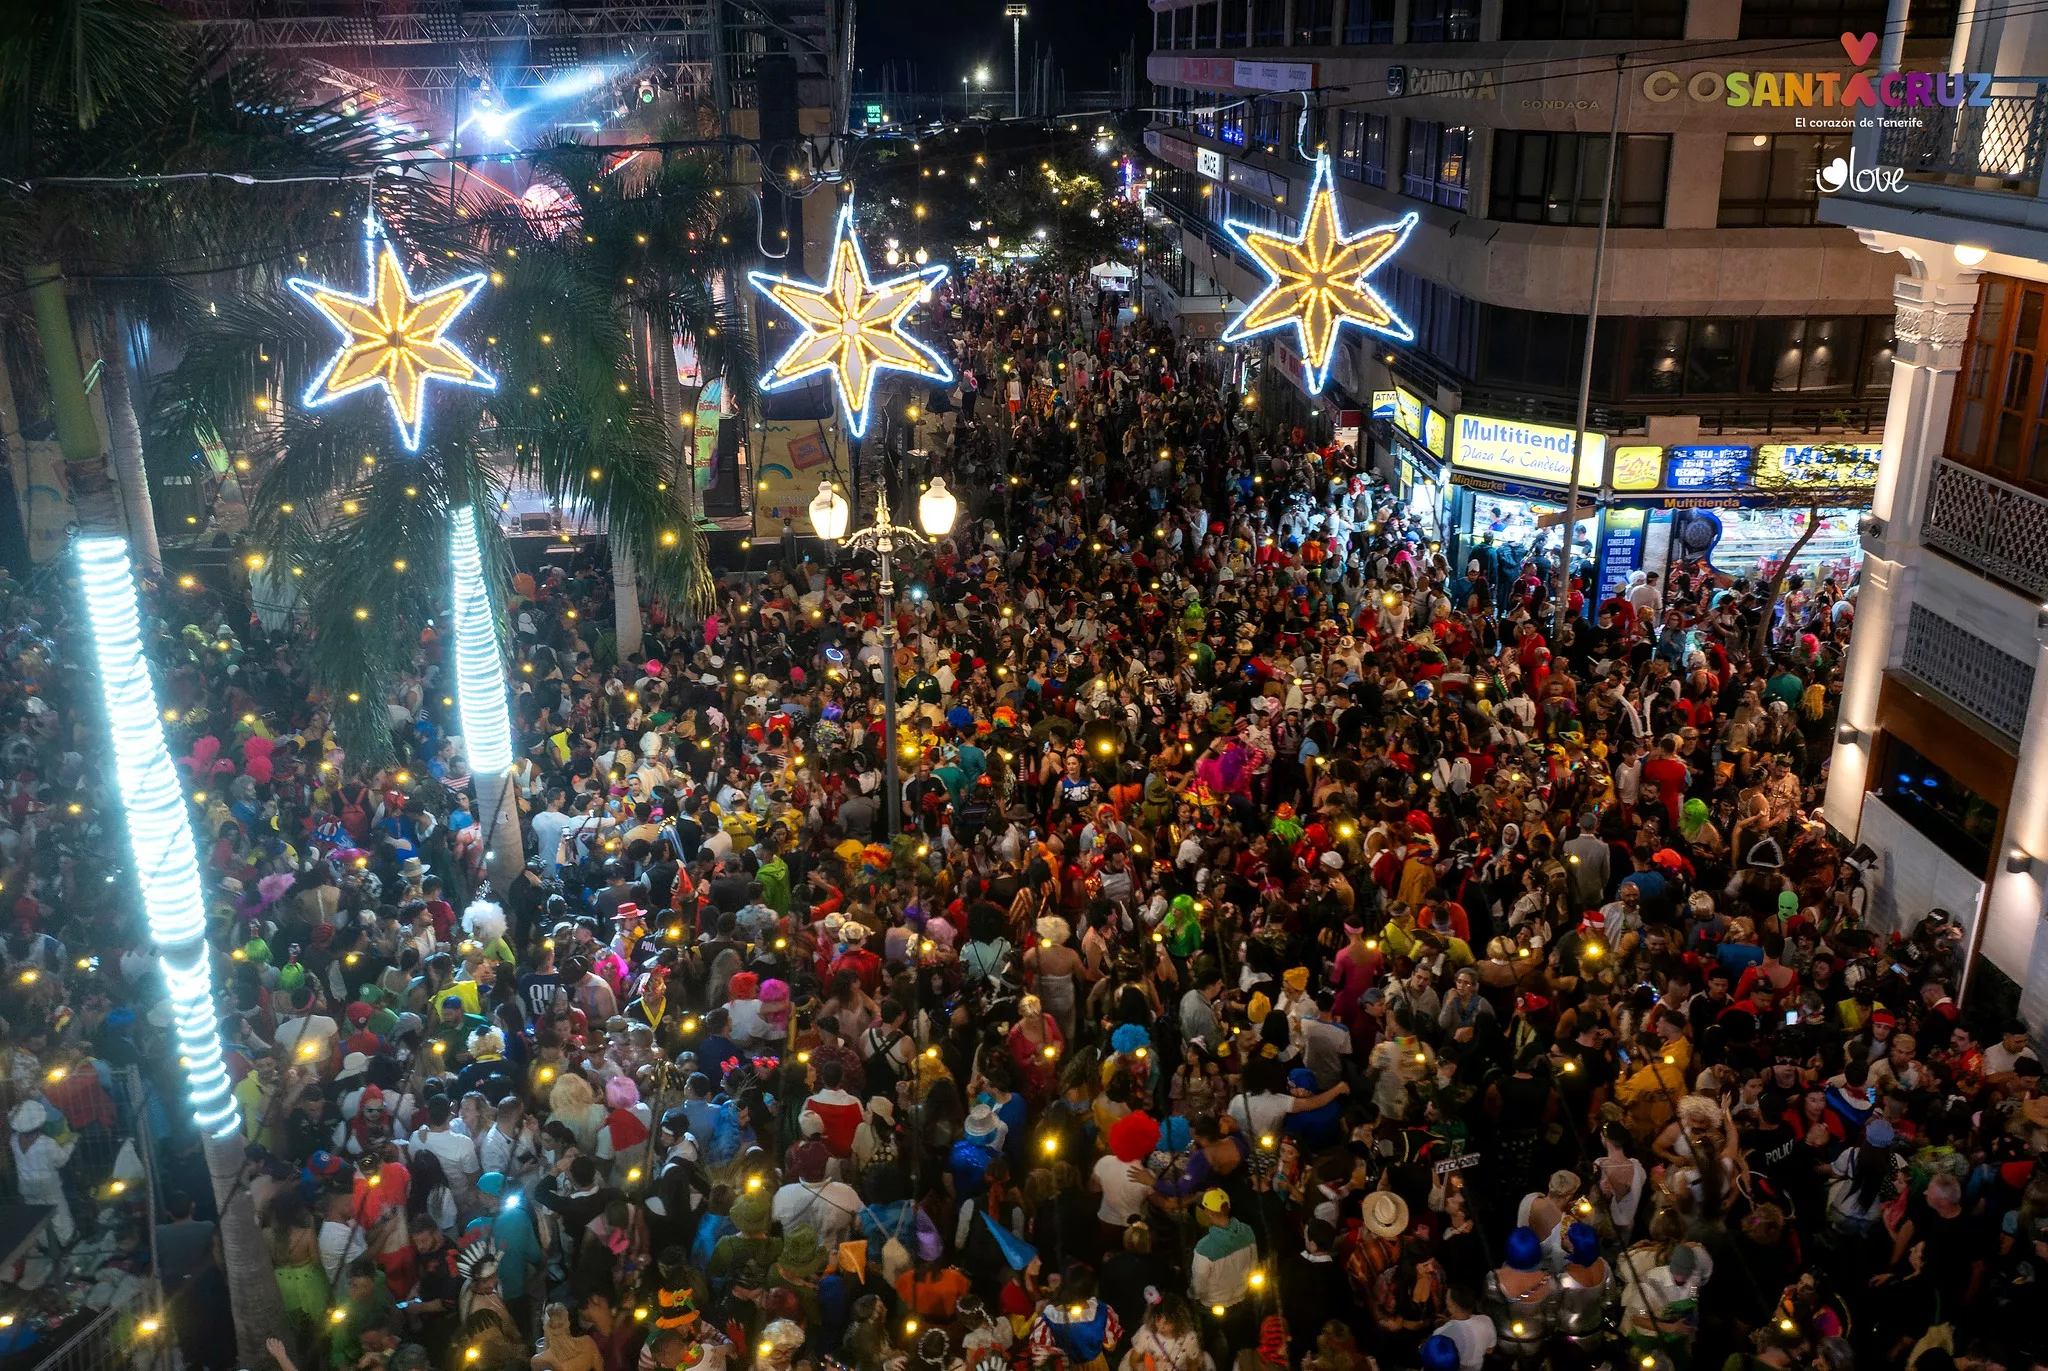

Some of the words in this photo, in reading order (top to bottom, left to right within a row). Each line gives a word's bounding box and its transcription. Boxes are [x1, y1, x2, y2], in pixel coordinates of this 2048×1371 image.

[1410, 68, 1496, 100] CONDACA
[1521, 99, 1600, 110] CONDACA
[1203, 153, 1216, 174] RACE
[1375, 393, 1396, 402] ATM
[1460, 444, 1494, 462] Plaza
[1500, 449, 1514, 464] La
[1519, 452, 1571, 475] Candelar
[1452, 473, 1507, 491] Minimarket
[1664, 497, 1741, 508] Multitienda
